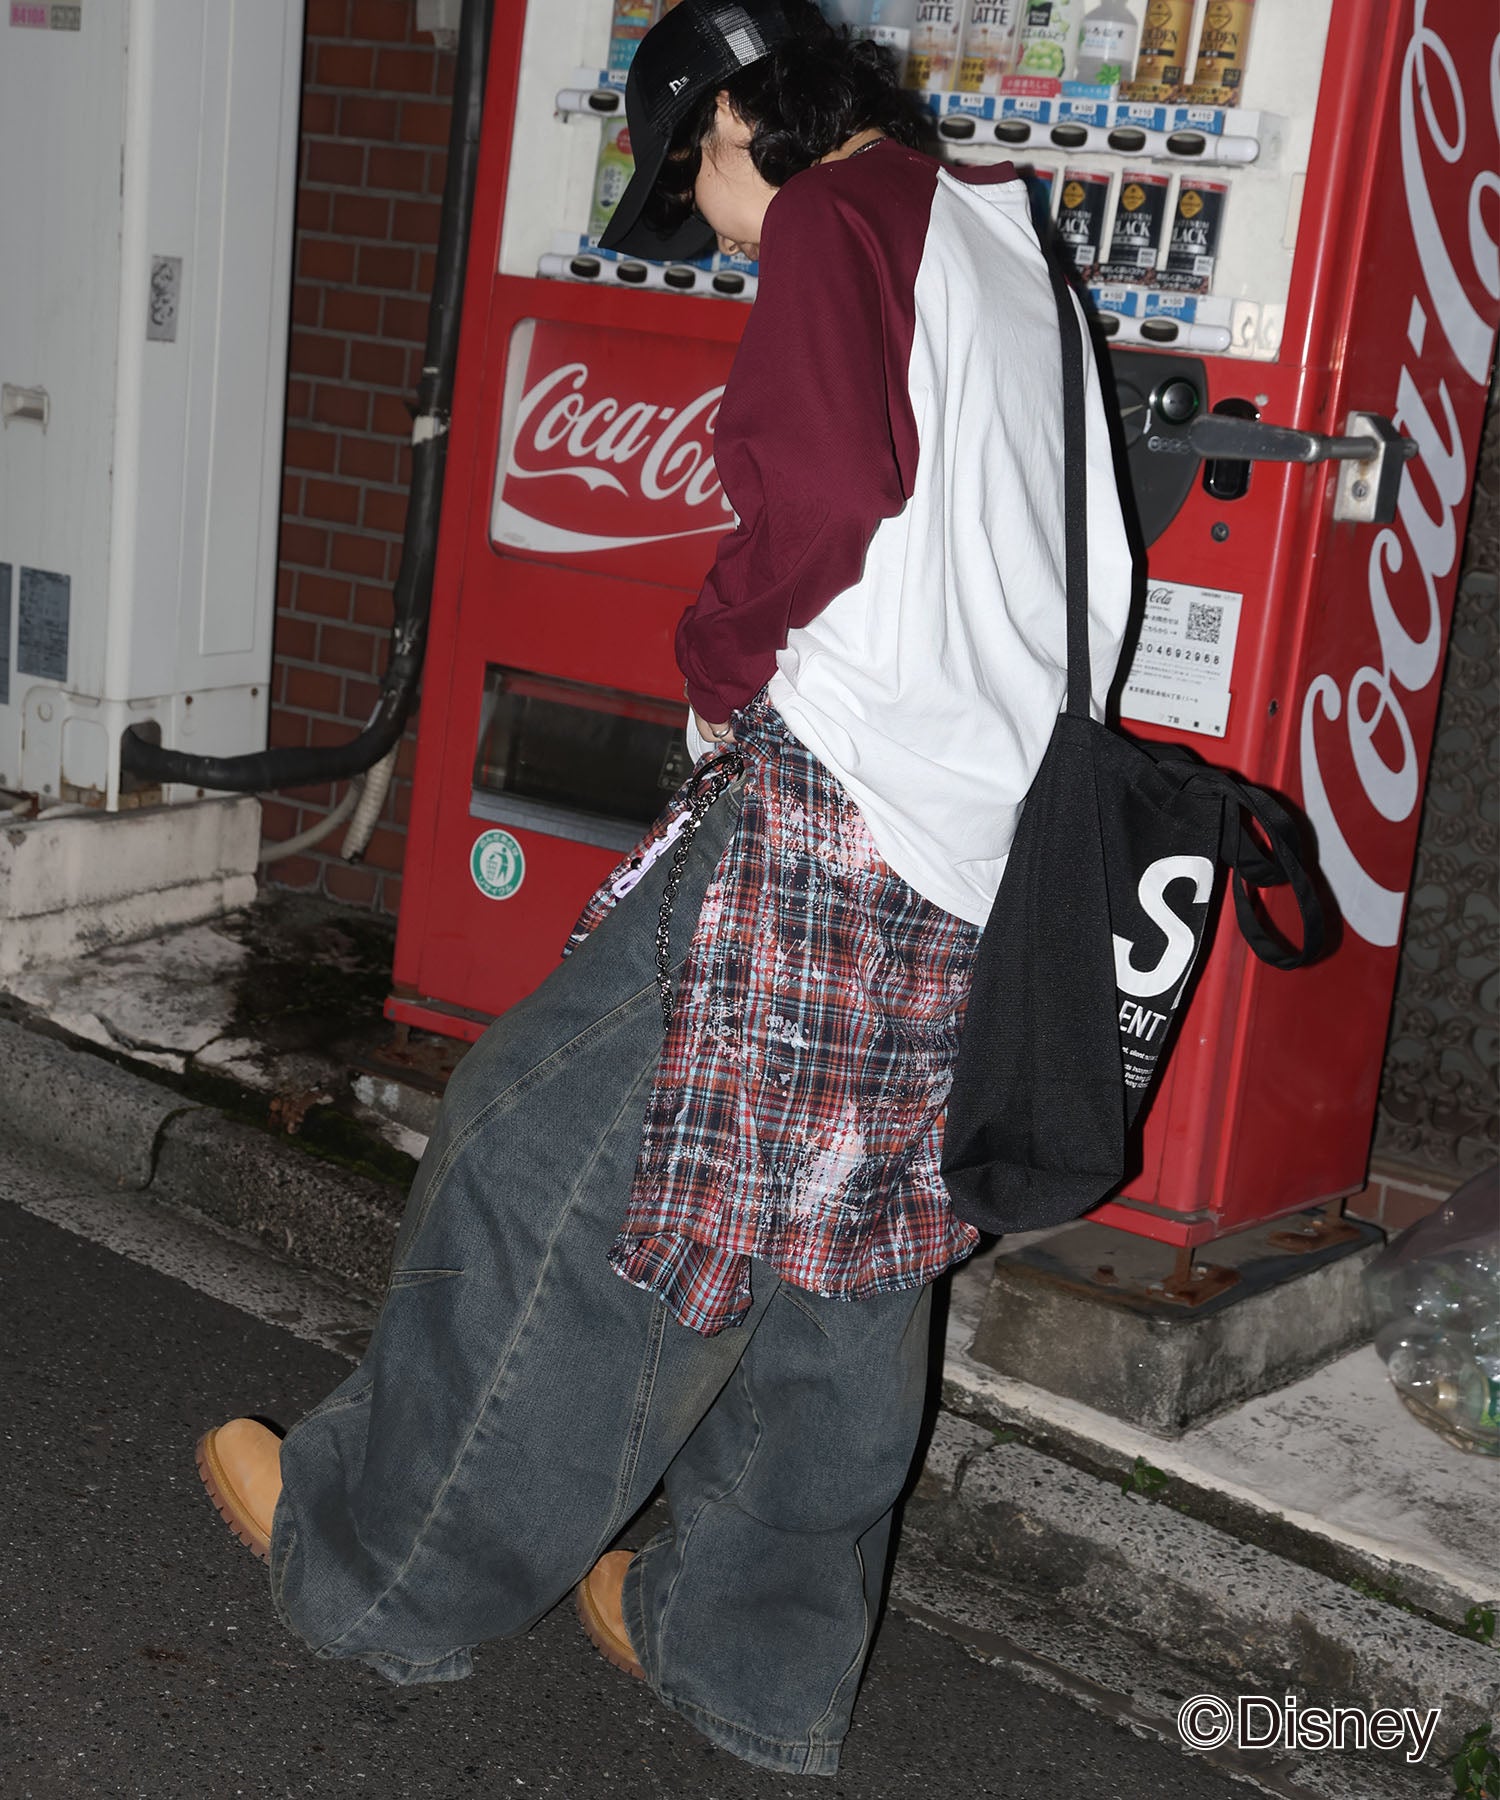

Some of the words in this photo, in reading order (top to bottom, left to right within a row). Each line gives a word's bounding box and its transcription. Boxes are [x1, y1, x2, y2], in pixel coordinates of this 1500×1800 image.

[916, 5, 952, 23] LATTE
[971, 7, 1008, 25] LATTE
[1115, 220, 1150, 238] LACK
[1173, 226, 1208, 246] LACK
[508, 363, 735, 511] Coca-Co
[1112, 855, 1214, 997] S
